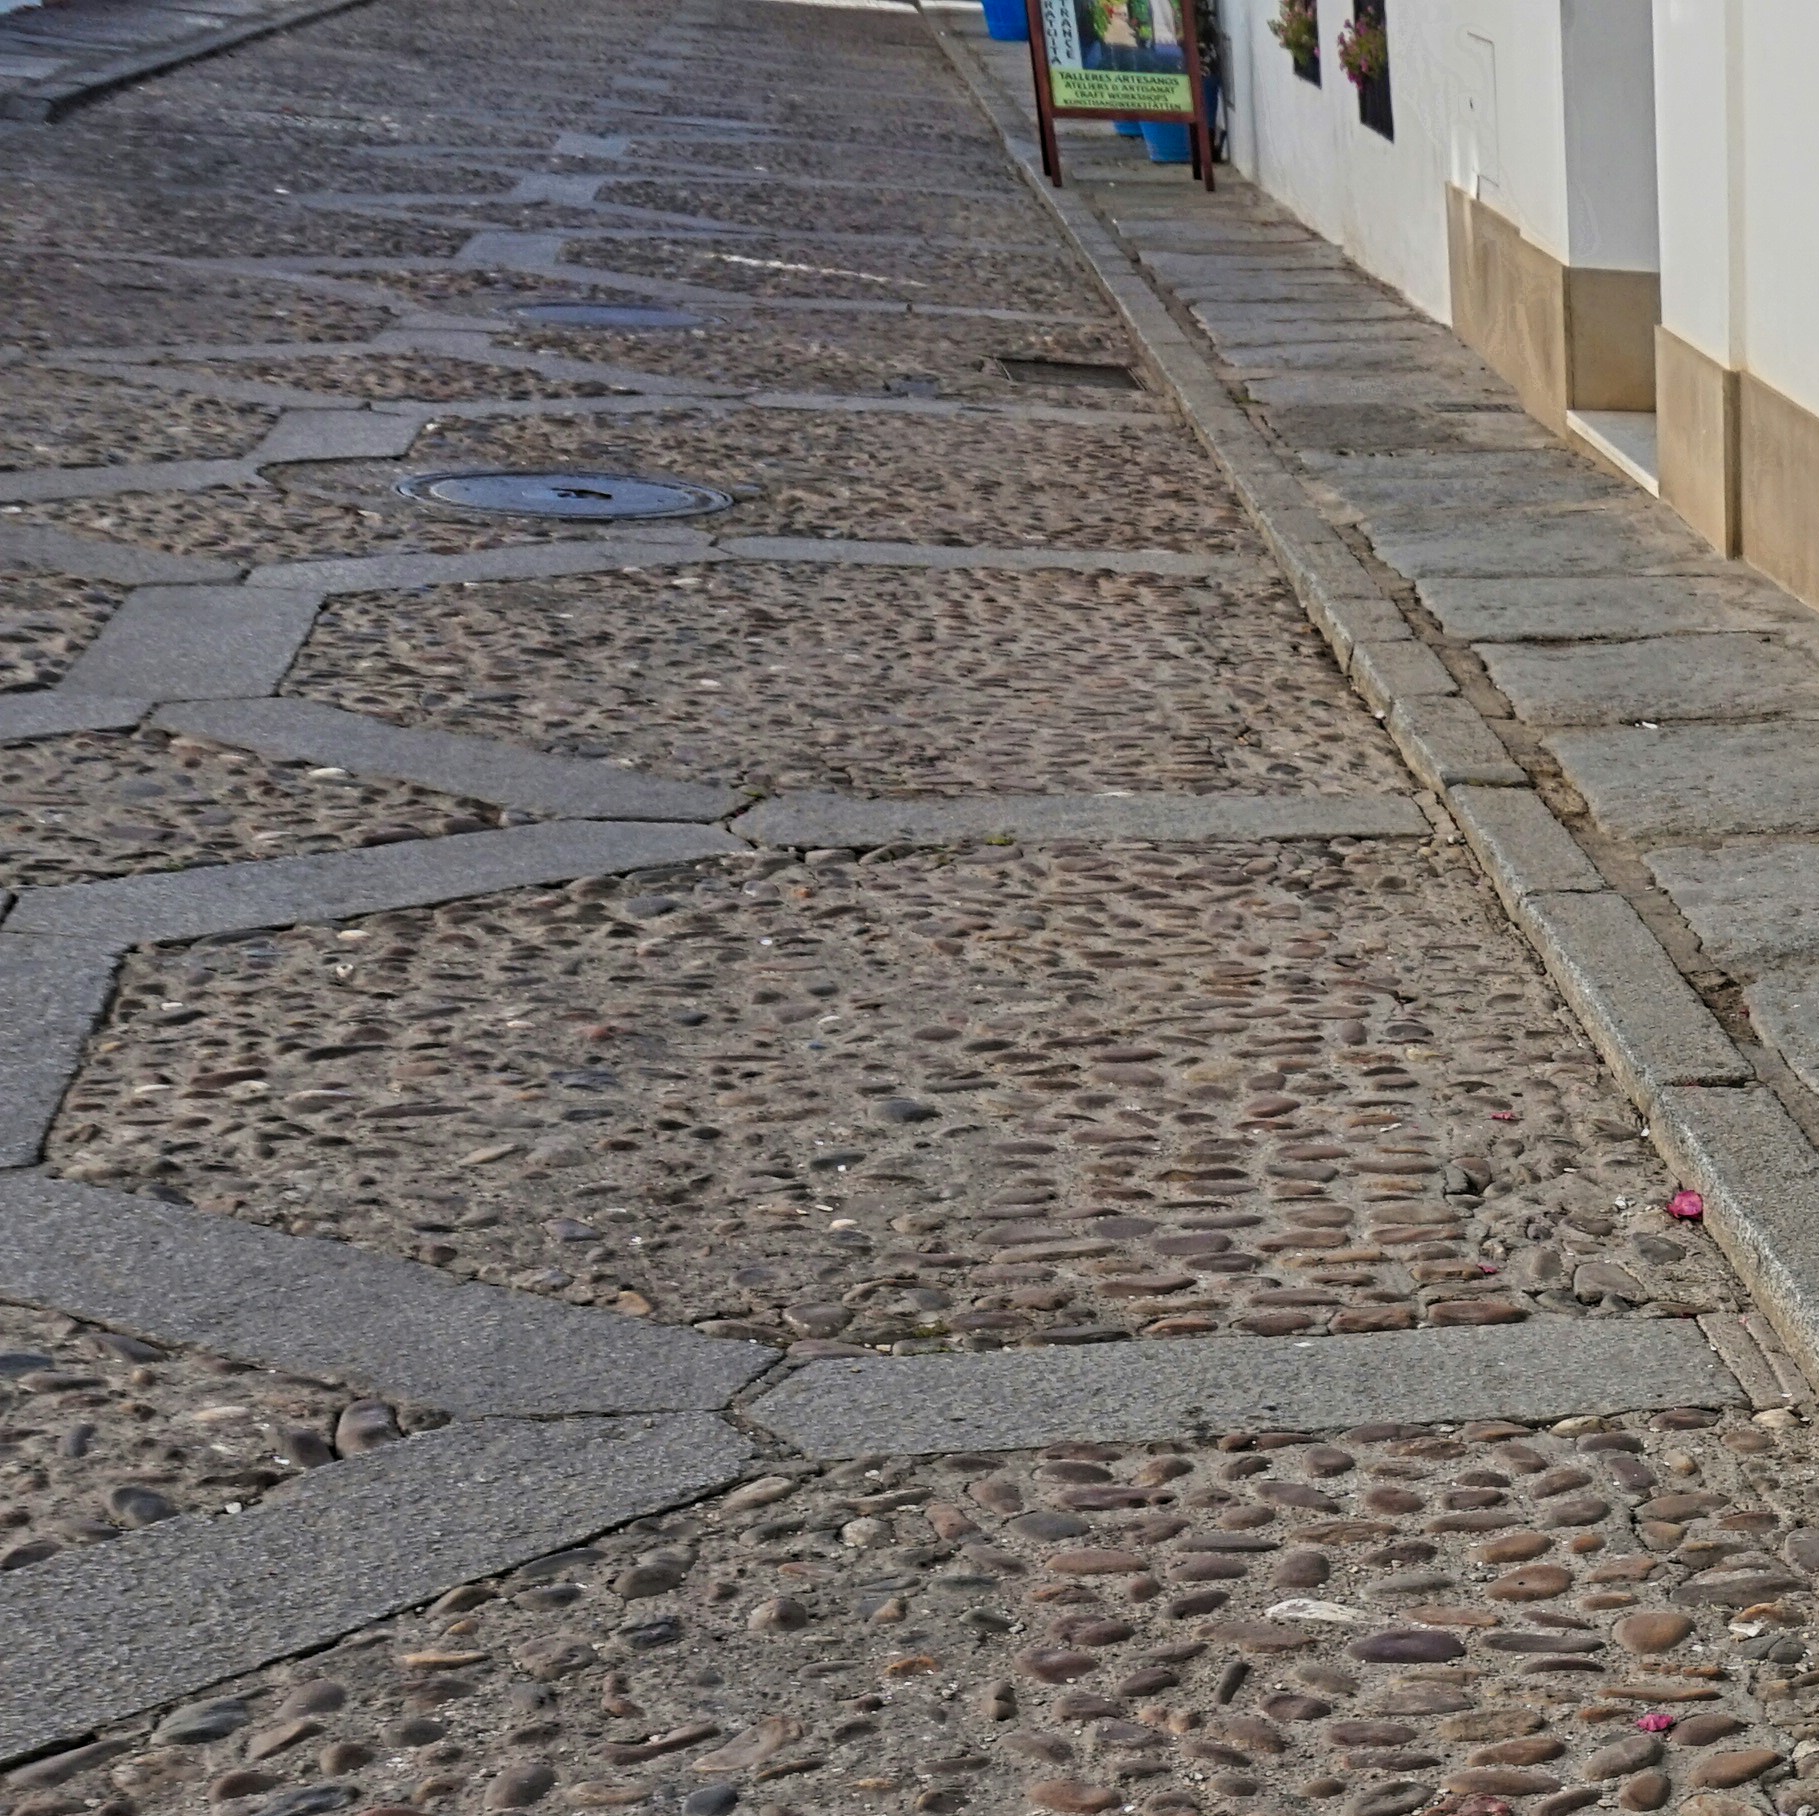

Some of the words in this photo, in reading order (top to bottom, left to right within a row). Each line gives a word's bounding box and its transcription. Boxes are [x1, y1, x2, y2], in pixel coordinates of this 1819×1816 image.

[1058, 71, 1112, 83] TALLERES
[1114, 74, 1180, 87] ARTESANOS
[1074, 90, 1105, 99] CRAFT
[1108, 92, 1169, 102] WORKSHOPS
